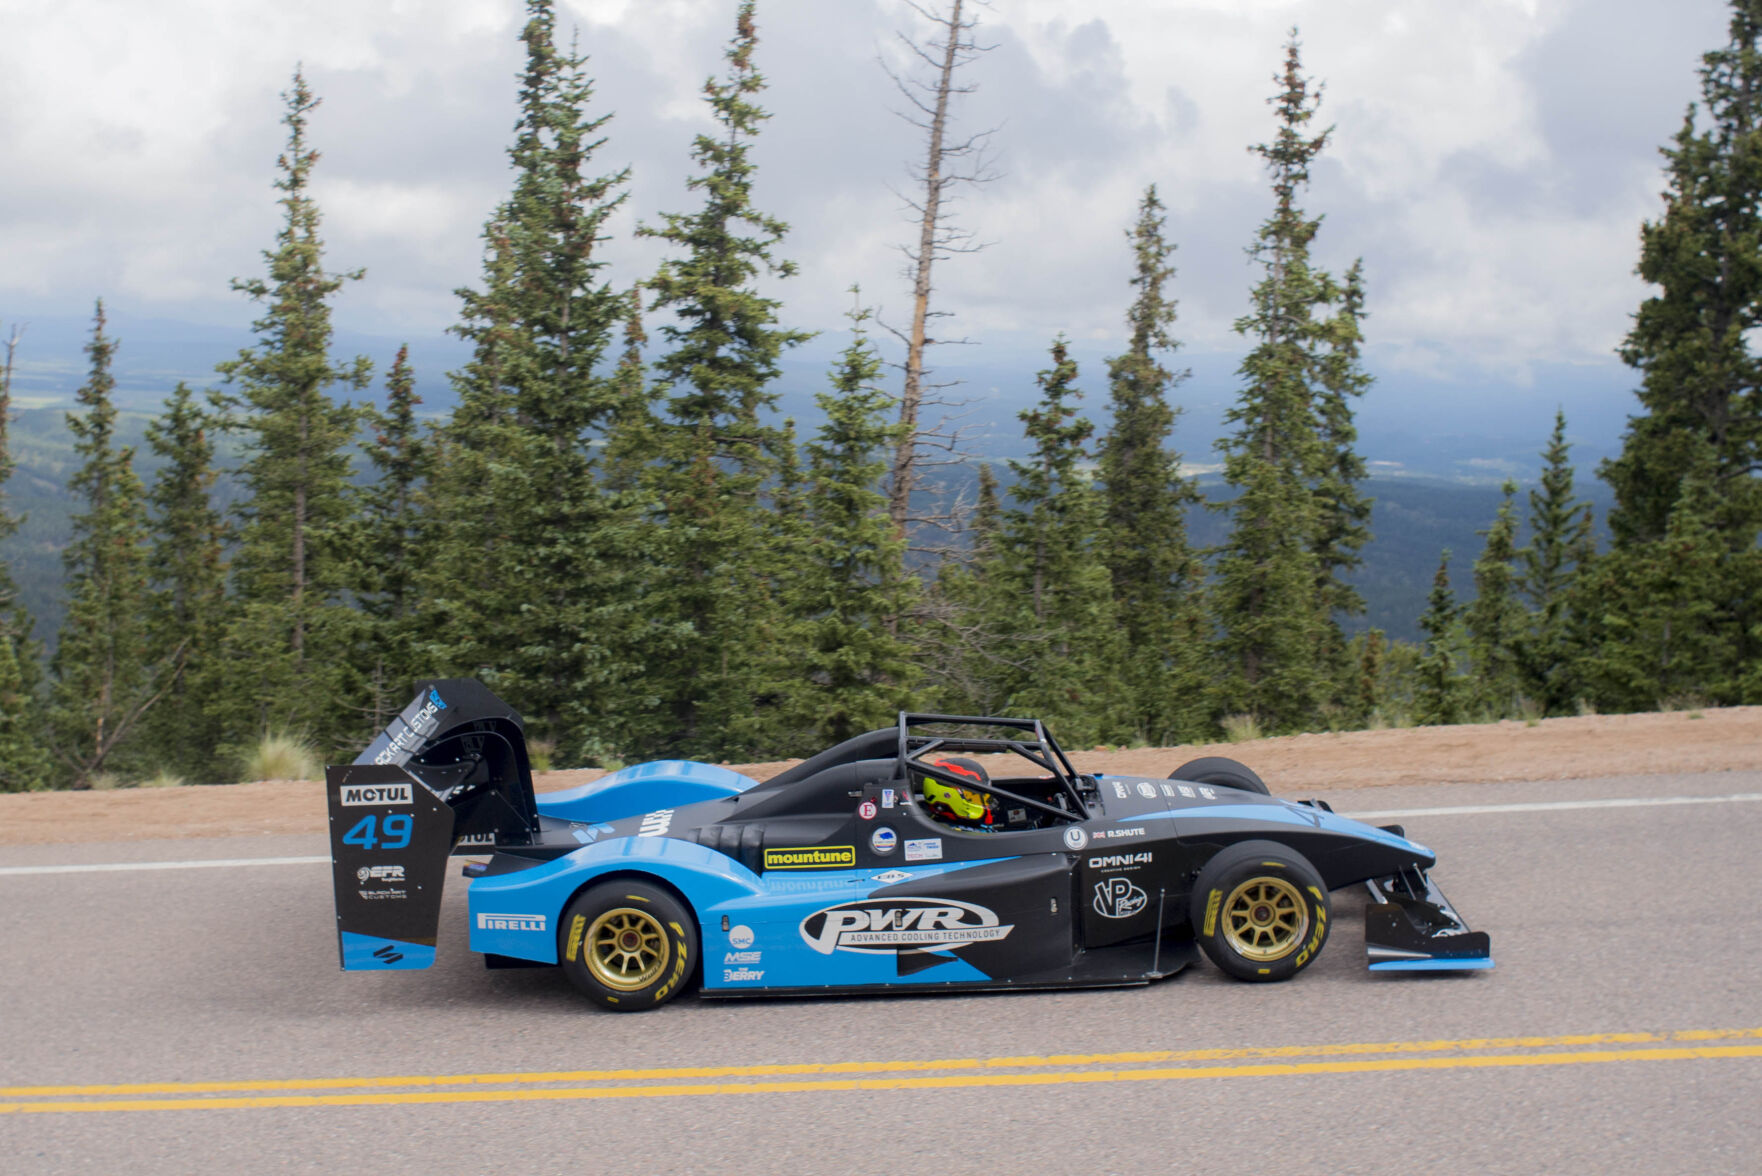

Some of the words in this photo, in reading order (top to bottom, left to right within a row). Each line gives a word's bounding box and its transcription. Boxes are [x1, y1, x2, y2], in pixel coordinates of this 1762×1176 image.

[346, 788, 408, 802] MOTUL
[863, 804, 873, 817] E
[343, 814, 414, 850] 49
[767, 851, 852, 865] mountune
[477, 913, 546, 930] PIRELLI
[816, 907, 966, 954] PWR
[851, 932, 899, 942] ADVANCED
[901, 931, 940, 941] COOLING
[943, 928, 1000, 940] TECHNOLOGY
